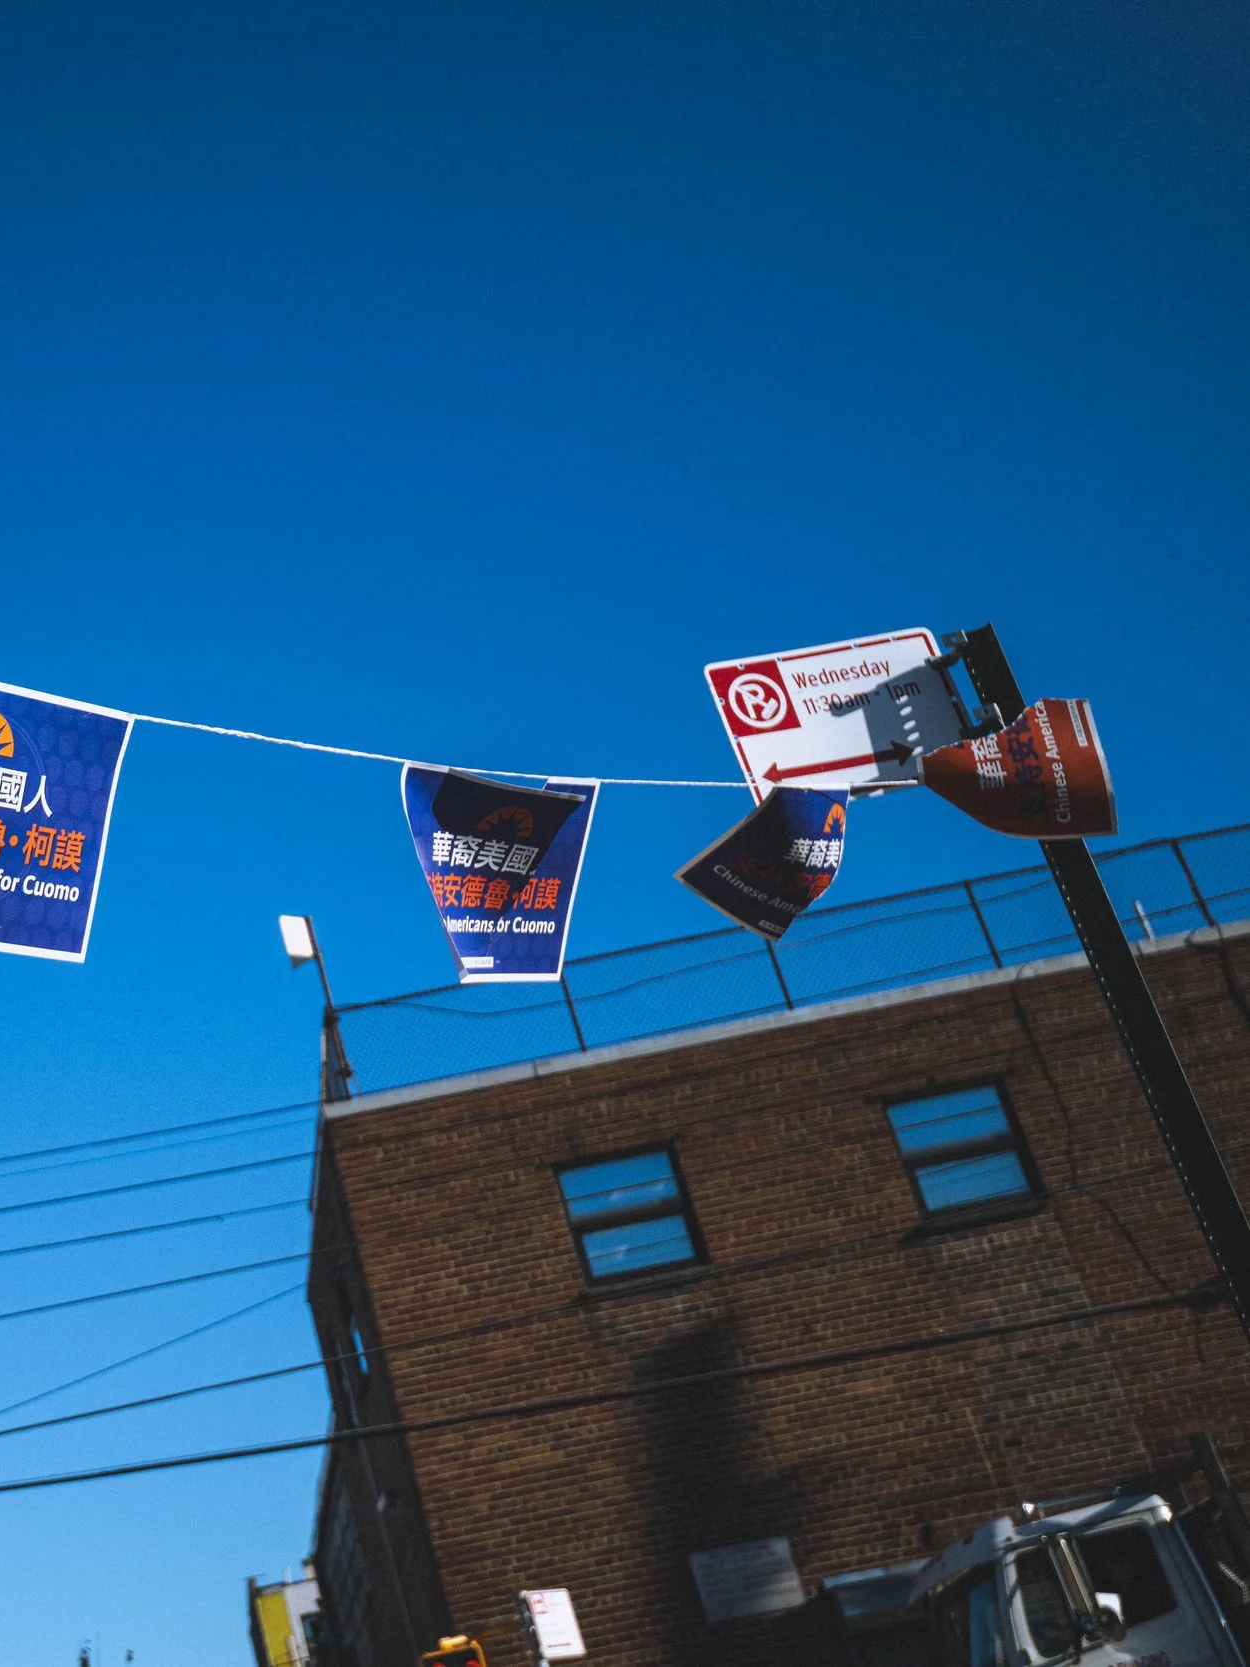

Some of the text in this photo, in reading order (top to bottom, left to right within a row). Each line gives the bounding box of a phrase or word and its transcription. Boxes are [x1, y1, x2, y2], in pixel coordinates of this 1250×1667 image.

[791, 659, 890, 689] Wednesday
[802, 692, 871, 716] 11:30am
[885, 681, 922, 702] 1pm
[1052, 761, 1071, 823] Chinese
[432, 830, 540, 875] 華裔美國
[22, 875, 80, 902] Cuomo
[713, 864, 768, 901] Chinese
[512, 916, 556, 934] Cuomo
